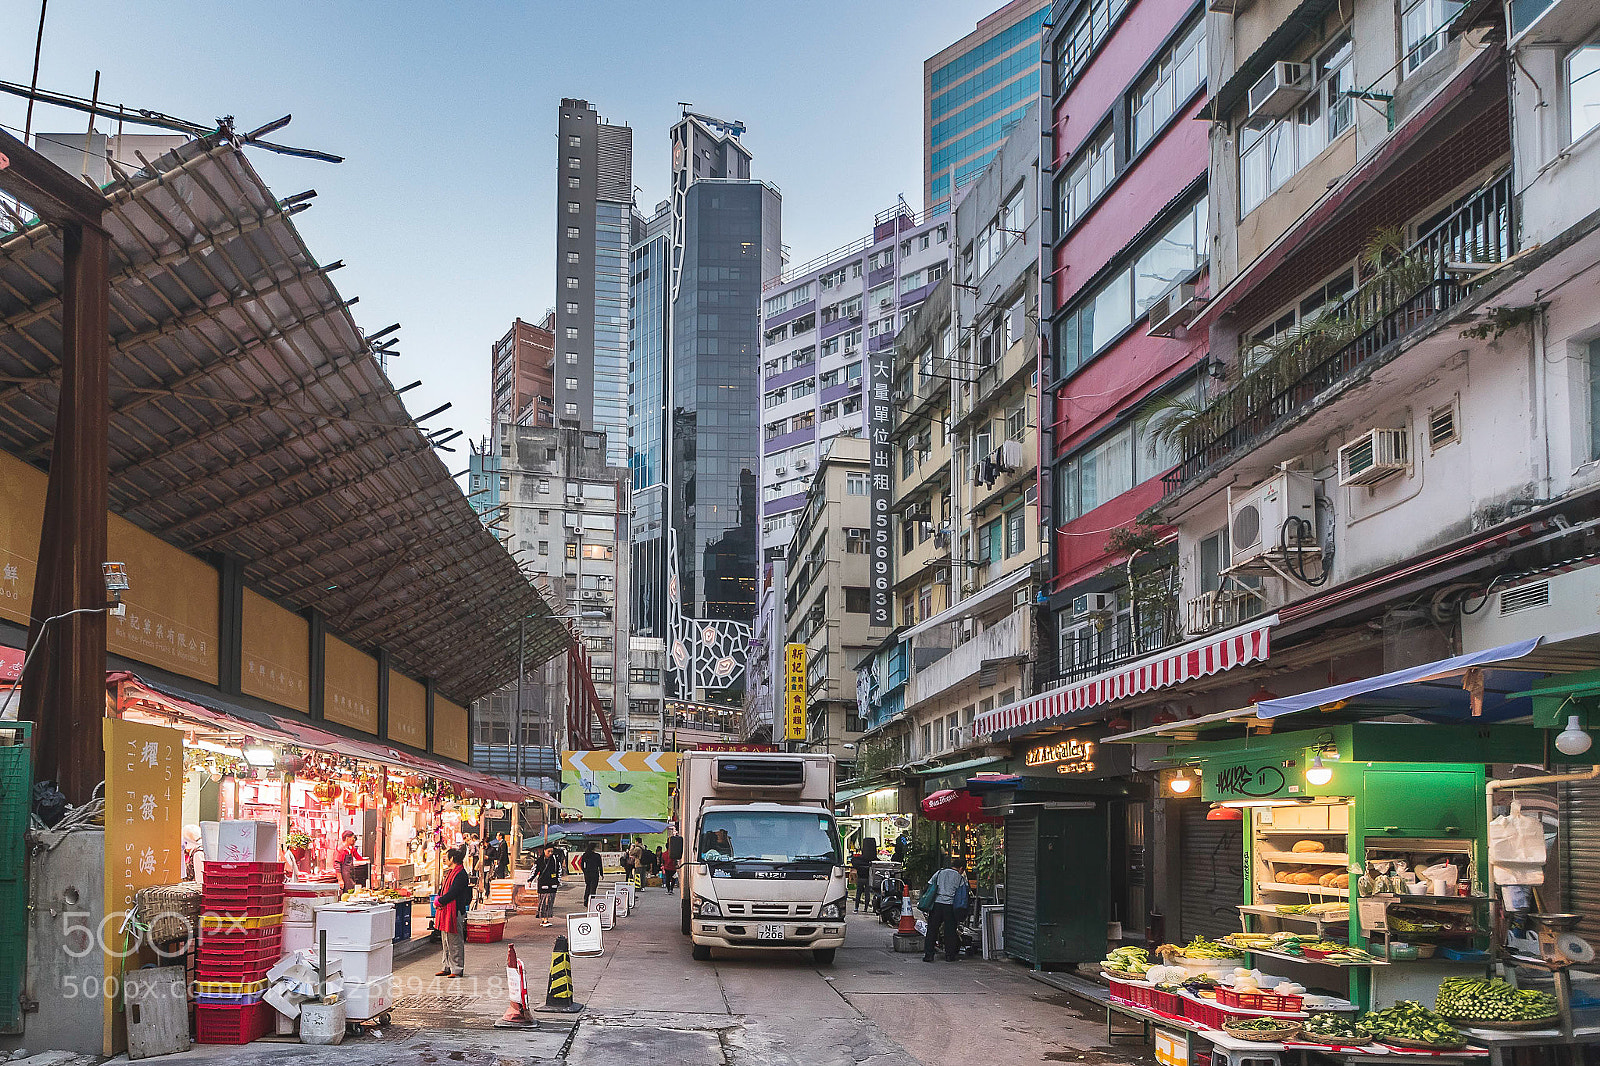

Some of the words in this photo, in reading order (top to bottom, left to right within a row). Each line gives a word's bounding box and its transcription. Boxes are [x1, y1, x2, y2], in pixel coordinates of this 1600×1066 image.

[873, 360, 890, 491] 大量單位出租
[875, 499, 888, 621] 65569633
[791, 648, 804, 673] 新記
[127, 739, 137, 772] Yiu
[163, 745, 173, 822] 2541
[125, 791, 136, 825] Fat
[759, 931, 783, 939] 7206
[765, 924, 778, 932] NE
